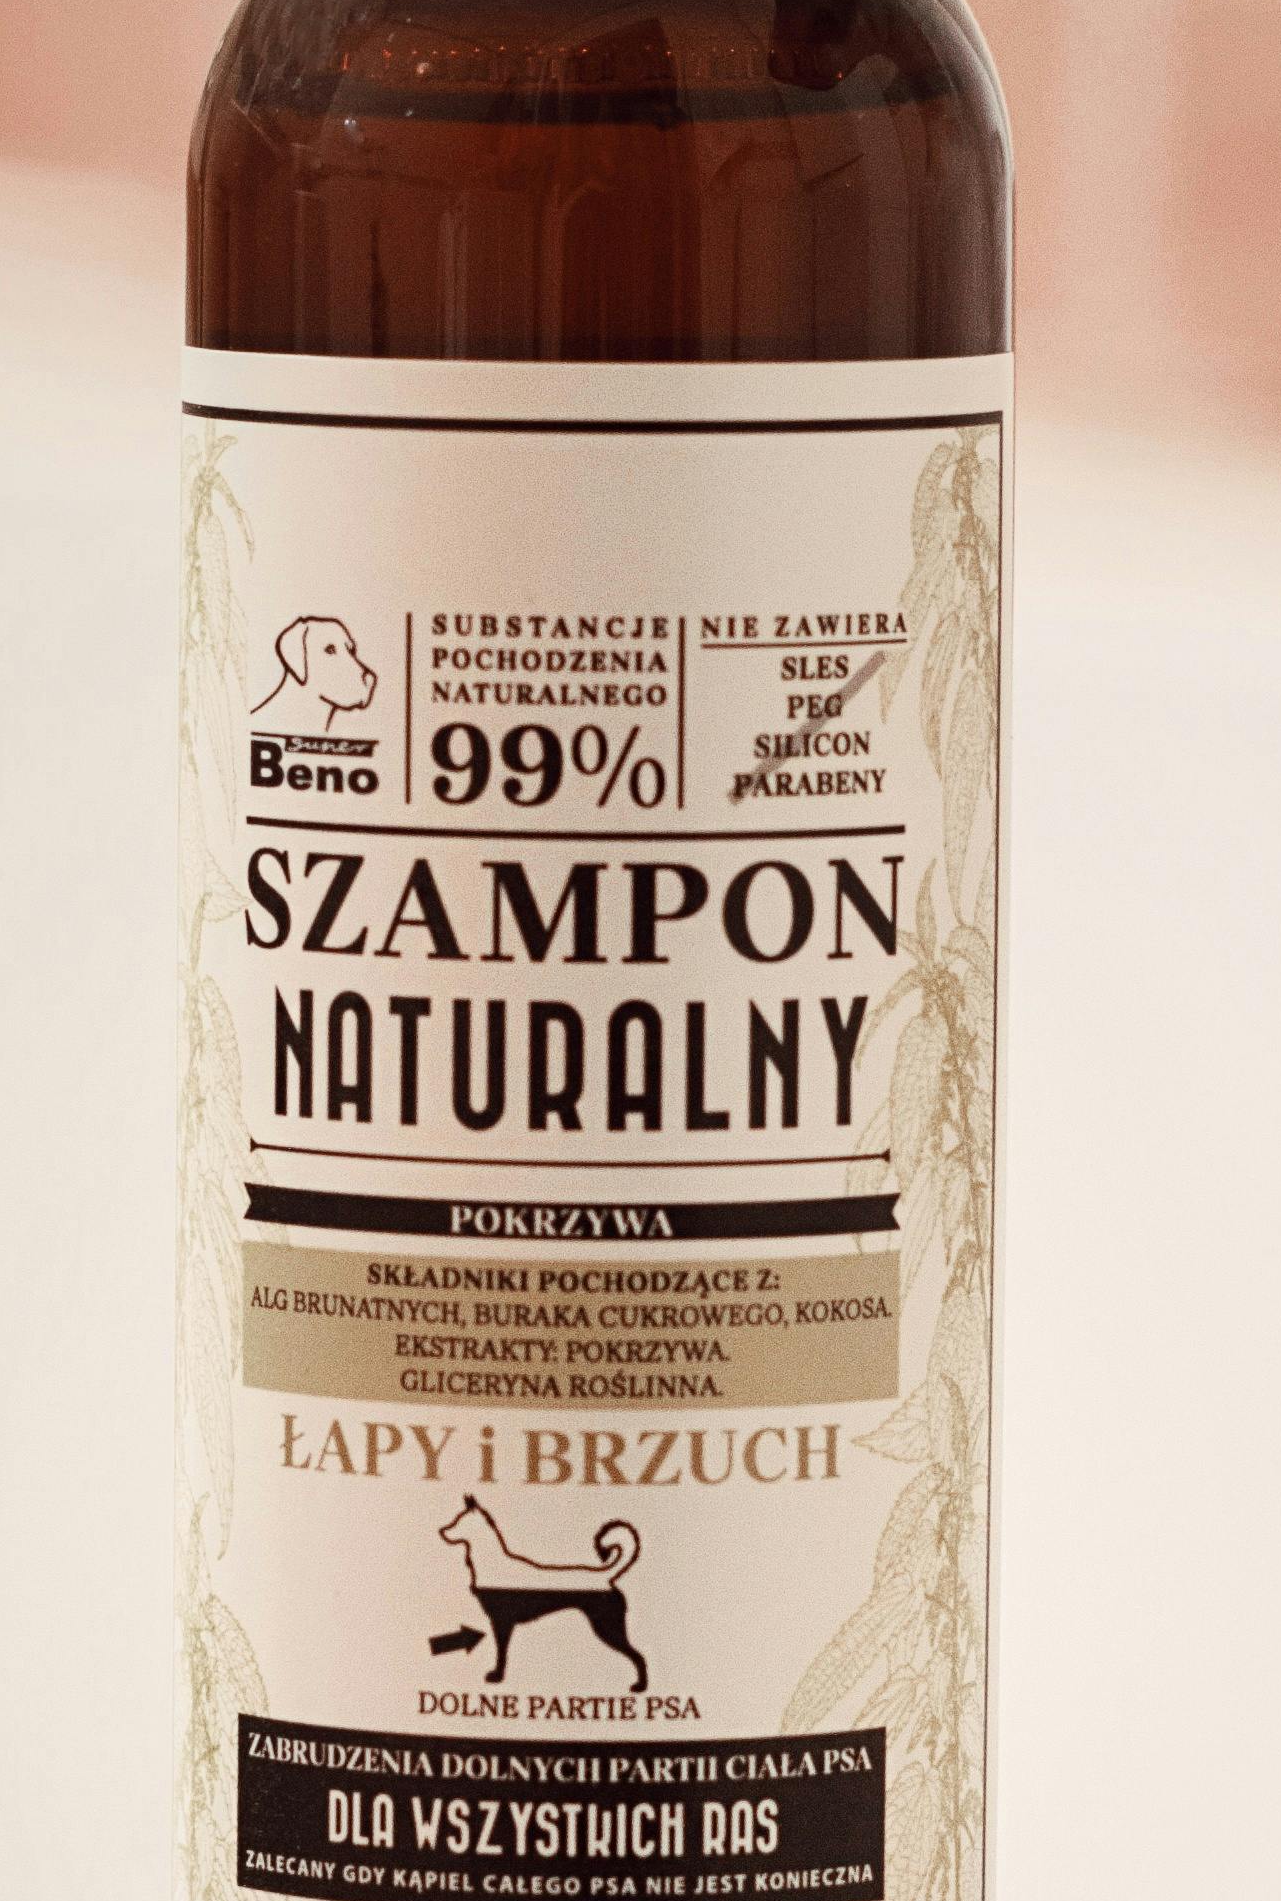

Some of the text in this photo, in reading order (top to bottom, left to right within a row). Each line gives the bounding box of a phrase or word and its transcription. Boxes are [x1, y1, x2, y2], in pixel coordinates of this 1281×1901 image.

[431, 613, 668, 639] SUBSTANCJE
[701, 612, 908, 639] NIE ZAWIERA
[431, 648, 667, 673] POCHODZENIA
[780, 654, 850, 681] SLES
[431, 681, 667, 707] NATURALNEGO
[786, 693, 843, 719] PEG
[753, 730, 871, 759] SILICON
[250, 740, 380, 795] Beno
[431, 722, 666, 808] 99%
[732, 768, 887, 797] PARABENY
[244, 846, 905, 964] SZAMPON
[273, 985, 869, 1133] NATURALNY
[450, 1204, 674, 1238] POKRZYWA
[367, 1262, 782, 1299] SKŁADNIKI POCHODZĄCE Z:
[250, 1285, 893, 1330] ALG BRUNATNYCH, BURAKA CUKROWEGO, KOKOSA.
[394, 1333, 732, 1364] EKSTRAKTY: POKRZYWA.
[399, 1369, 724, 1400] GLICERYNA ROŚLINNA.
[279, 1413, 842, 1487] ŁAPY i BRZUCH
[417, 1690, 702, 1722] DOLNE PARTIE PSA
[248, 1731, 435, 1778] ZABRUDZENIA
[441, 1752, 601, 1783] DOLNYCH
[609, 1754, 719, 1784] PARTII
[822, 1746, 873, 1776] PSA
[328, 1789, 780, 1858] DLA WSZYSTKICH RAS
[245, 1850, 874, 1897] ZALECANY GDY KĄPIEL CAŁEGO PSA NIE JEST KONIECZNA
